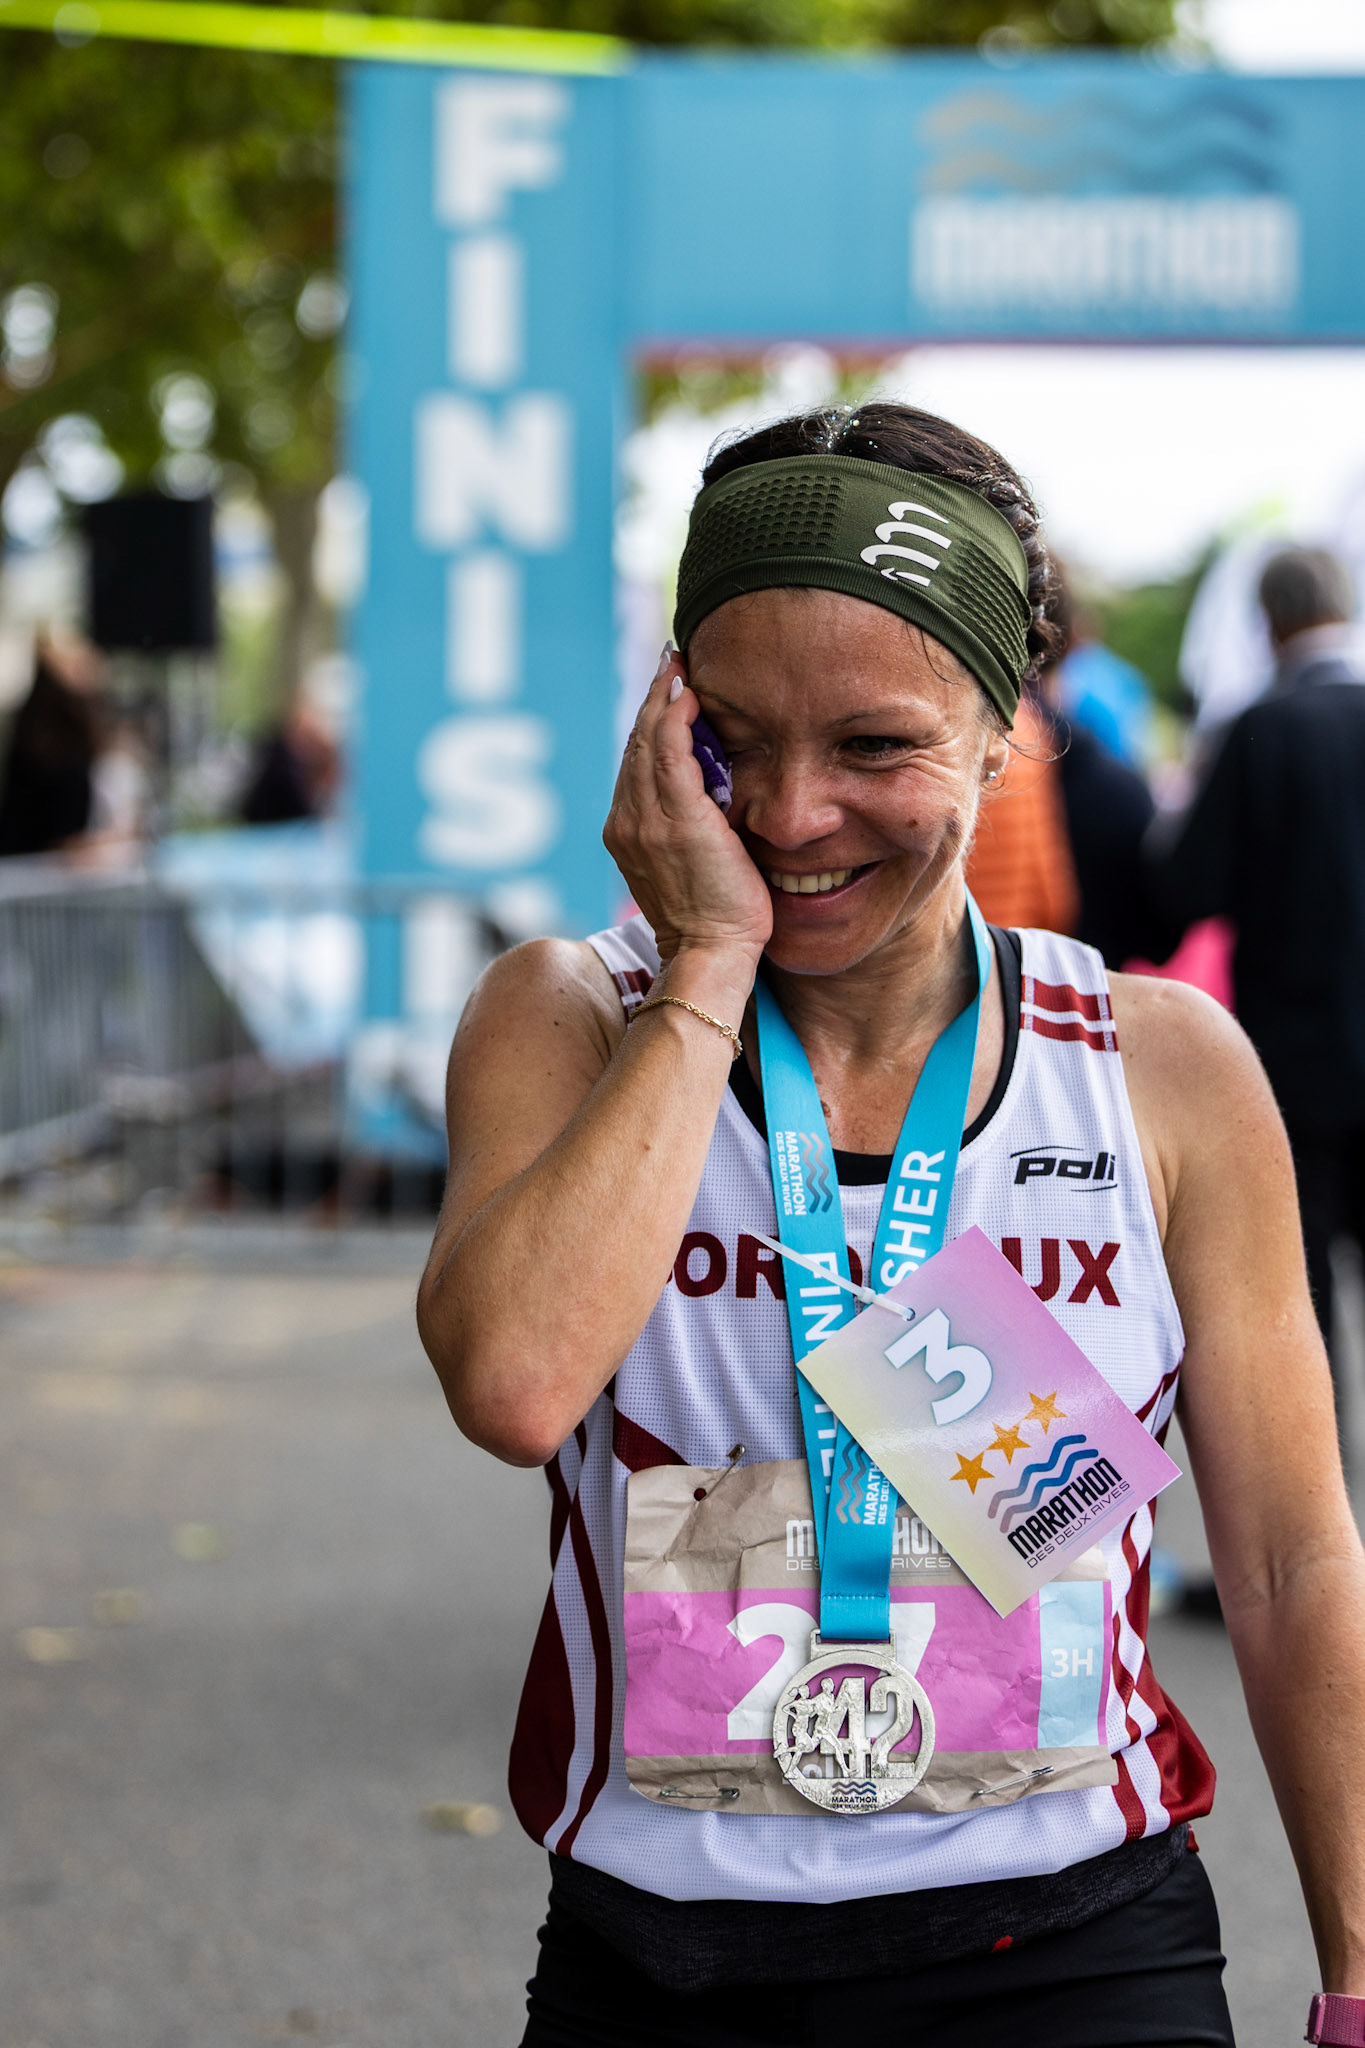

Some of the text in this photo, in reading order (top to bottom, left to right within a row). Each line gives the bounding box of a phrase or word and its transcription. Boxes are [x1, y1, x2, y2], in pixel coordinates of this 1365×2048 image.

[776, 1131, 793, 1216] DES DEUX RIVES
[784, 1131, 807, 1216] MARATHON
[1014, 1151, 1117, 1185] poli
[880, 1149, 946, 1288] SHER
[884, 1308, 993, 1426] 3
[863, 1461, 882, 1525] MARATH
[878, 1476, 890, 1525] DES DEU
[1007, 1457, 1123, 1560] MARATHON
[1026, 1480, 1131, 1568] DES DEUX RIVES
[891, 1557, 952, 1569] RIVES
[1051, 1647, 1094, 1679] 3H
[820, 1675, 915, 1778] 42
